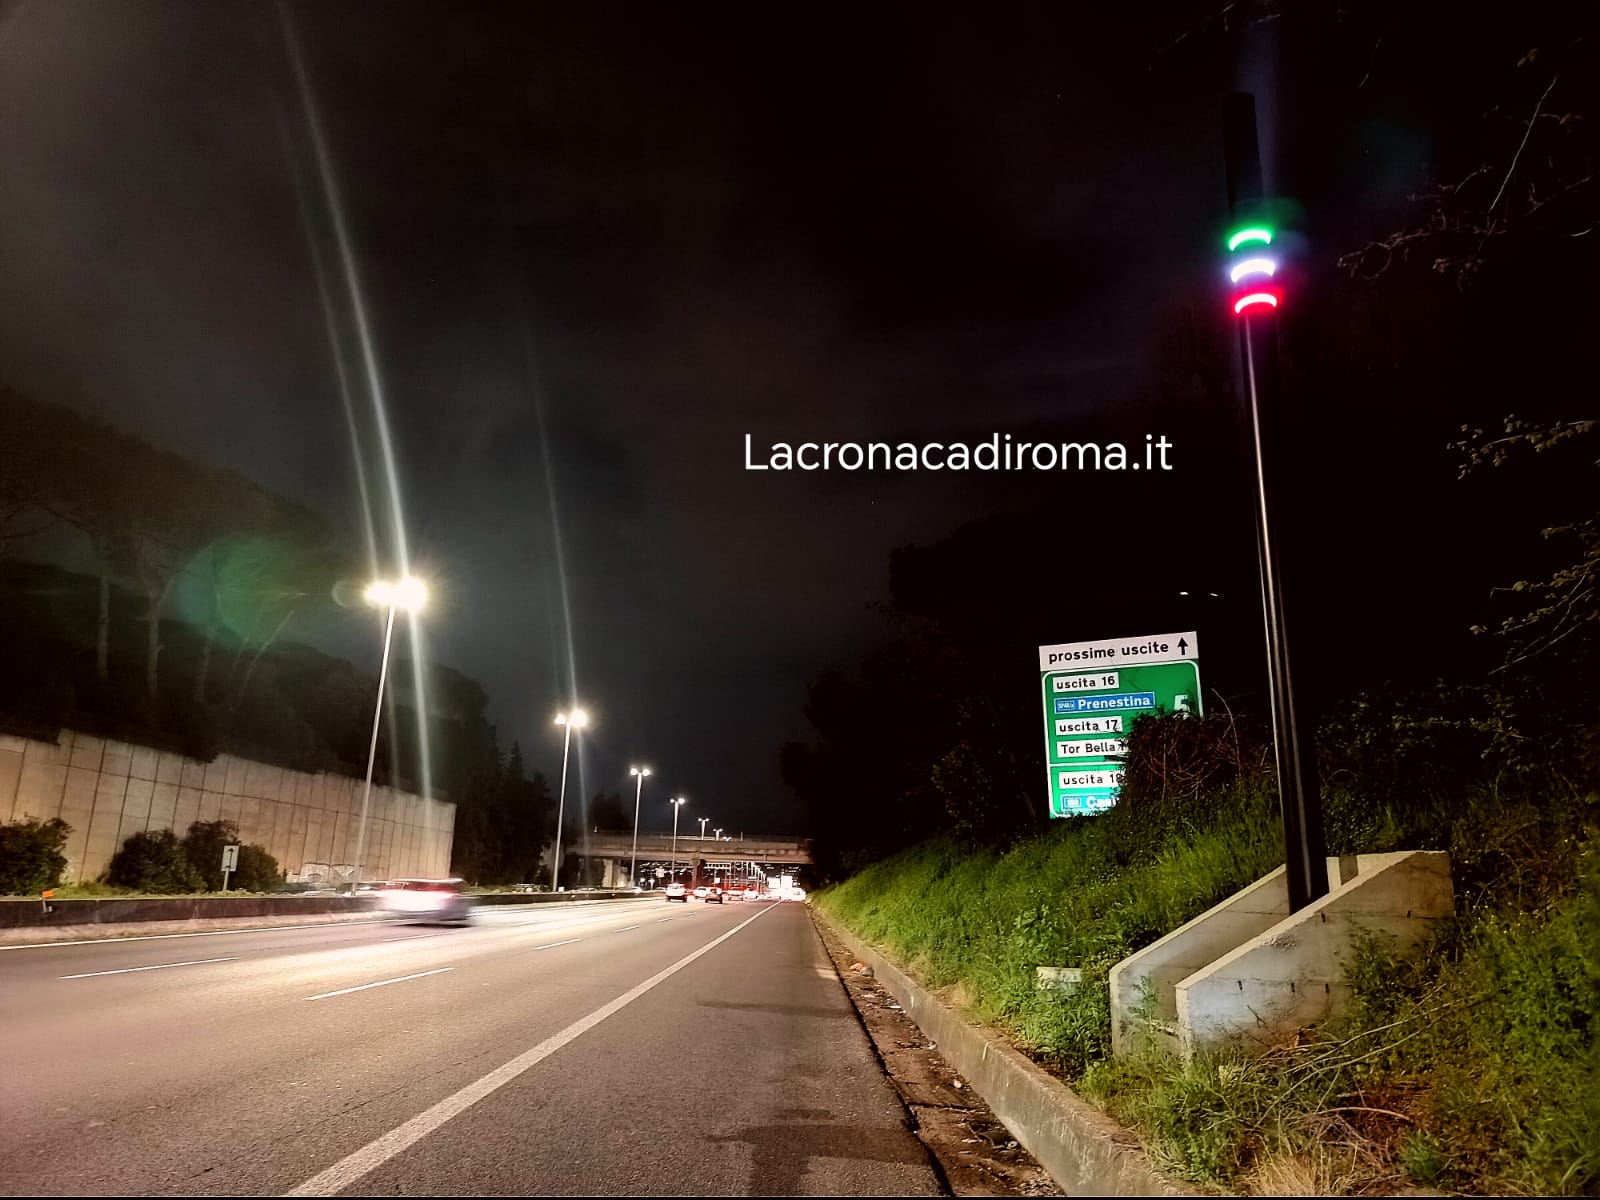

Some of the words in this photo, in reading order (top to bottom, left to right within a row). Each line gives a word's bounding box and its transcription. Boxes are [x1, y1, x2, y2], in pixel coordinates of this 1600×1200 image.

[1048, 647, 1116, 664] prossime
[1121, 641, 1169, 656] uscite
[1056, 678, 1096, 690] uscita
[1101, 675, 1116, 687] 16
[1078, 694, 1151, 710] Prenestina
[1059, 721, 1099, 733] uscita
[1105, 719, 1118, 731] 17
[1061, 743, 1081, 755] Tor
[1085, 741, 1116, 753] Bella
[1063, 774, 1103, 785] uscita
